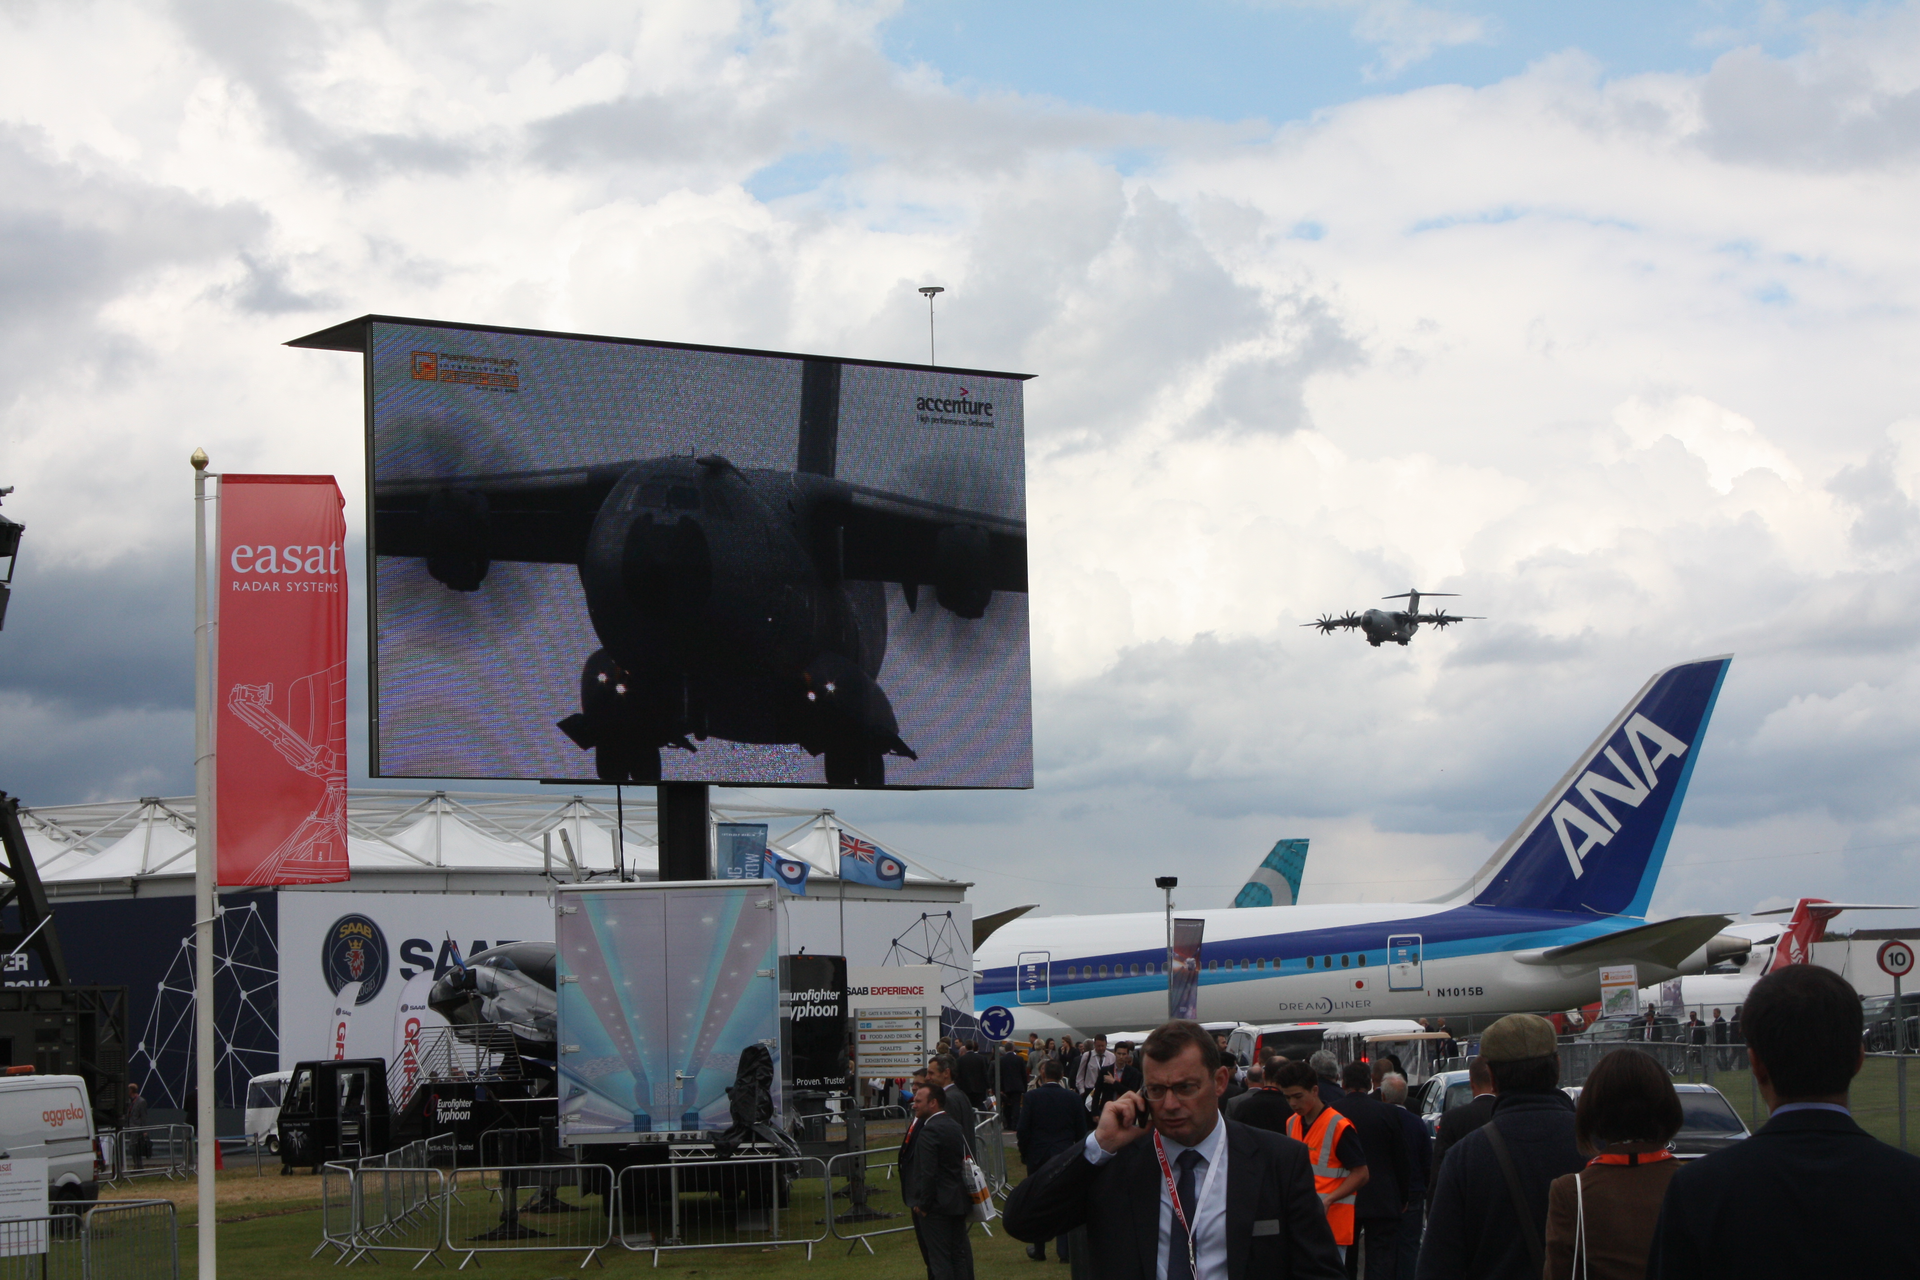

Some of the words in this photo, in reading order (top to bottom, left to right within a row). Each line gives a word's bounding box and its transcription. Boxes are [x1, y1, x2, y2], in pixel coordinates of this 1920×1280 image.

[916, 396, 993, 417] accenture
[231, 541, 341, 575] easat
[232, 581, 281, 592] RADAR
[286, 581, 339, 593] SYSTEMS
[1551, 712, 1689, 880] ANA
[339, 922, 373, 939] SAAB
[1888, 952, 1906, 966] 10
[790, 988, 840, 1003] urofighter
[847, 986, 869, 995] SAAB
[870, 986, 924, 995] EXPERIENCE
[1437, 987, 1484, 998] N1015B
[790, 1001, 839, 1021] yphoon
[1279, 997, 1371, 1014] DREAMLINER
[796, 1078, 821, 1086] Proven.
[437, 1098, 473, 1110] Eurofighter
[42, 1103, 84, 1127] aggreko
[436, 1108, 471, 1123] Typhoon
[1166, 1176, 1175, 1193] LEAP
